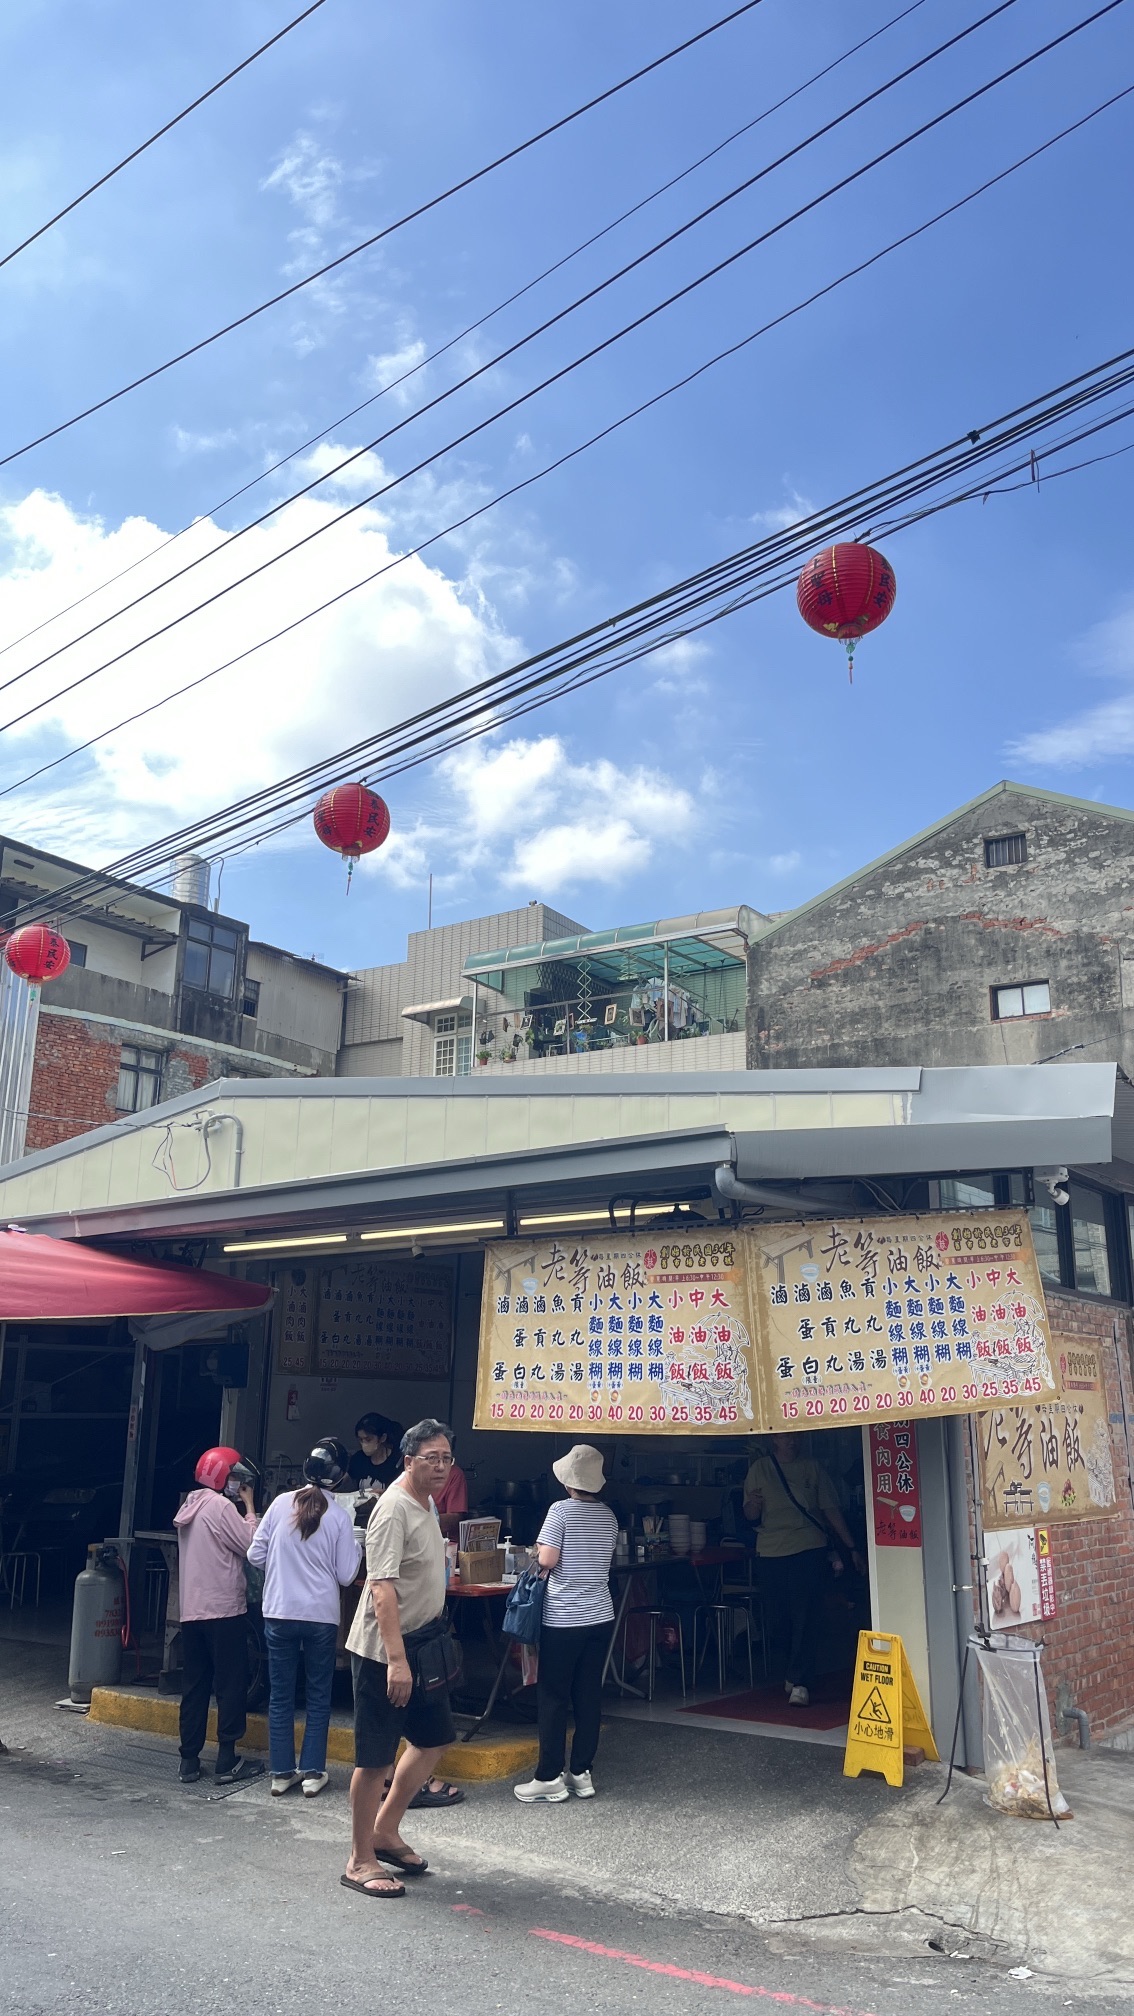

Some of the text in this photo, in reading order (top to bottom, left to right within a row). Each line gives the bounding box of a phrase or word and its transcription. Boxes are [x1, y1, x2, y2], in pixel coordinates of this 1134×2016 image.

[285, 1286, 296, 1342] 小滷肉飯
[296, 1286, 308, 1343] 大滷肉飯
[284, 1358, 304, 1366] 25 45
[331, 1359, 338, 1368] 20
[353, 1360, 360, 1368] 20
[364, 1360, 372, 1369] 20
[782, 1377, 1041, 1418] 15 20 20 20 20 30 40 20 30 25 35 45
[492, 1404, 738, 1421] 15 20 20 20 20 30 40 20 30 25 35 45
[866, 1662, 888, 1673] CAUTION
[860, 1672, 894, 1686] WET FLOOR
[854, 1721, 894, 1742] 小心地滑
